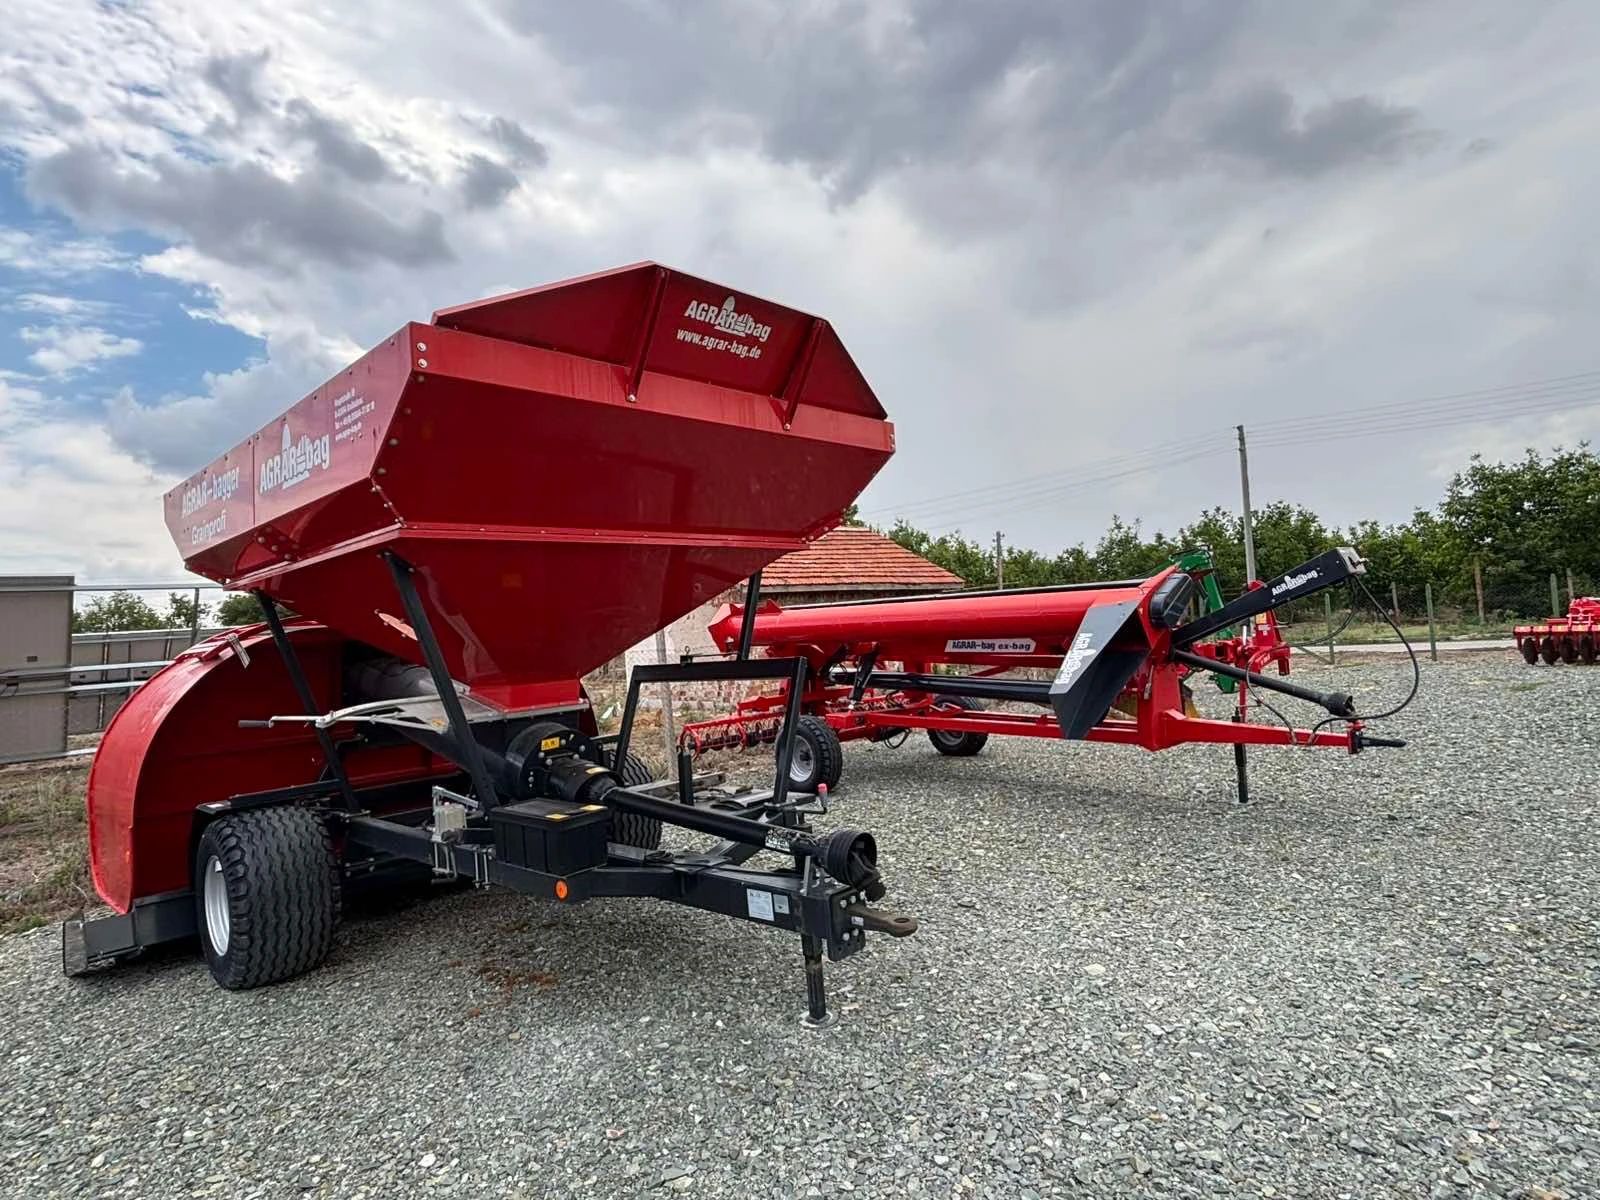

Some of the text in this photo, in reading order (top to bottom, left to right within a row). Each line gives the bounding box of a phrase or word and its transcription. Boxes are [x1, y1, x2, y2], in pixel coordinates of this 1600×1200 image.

[677, 329, 761, 358] www.agrar-bag.de
[952, 640, 1031, 651] AGRAR-bag ex-bag
